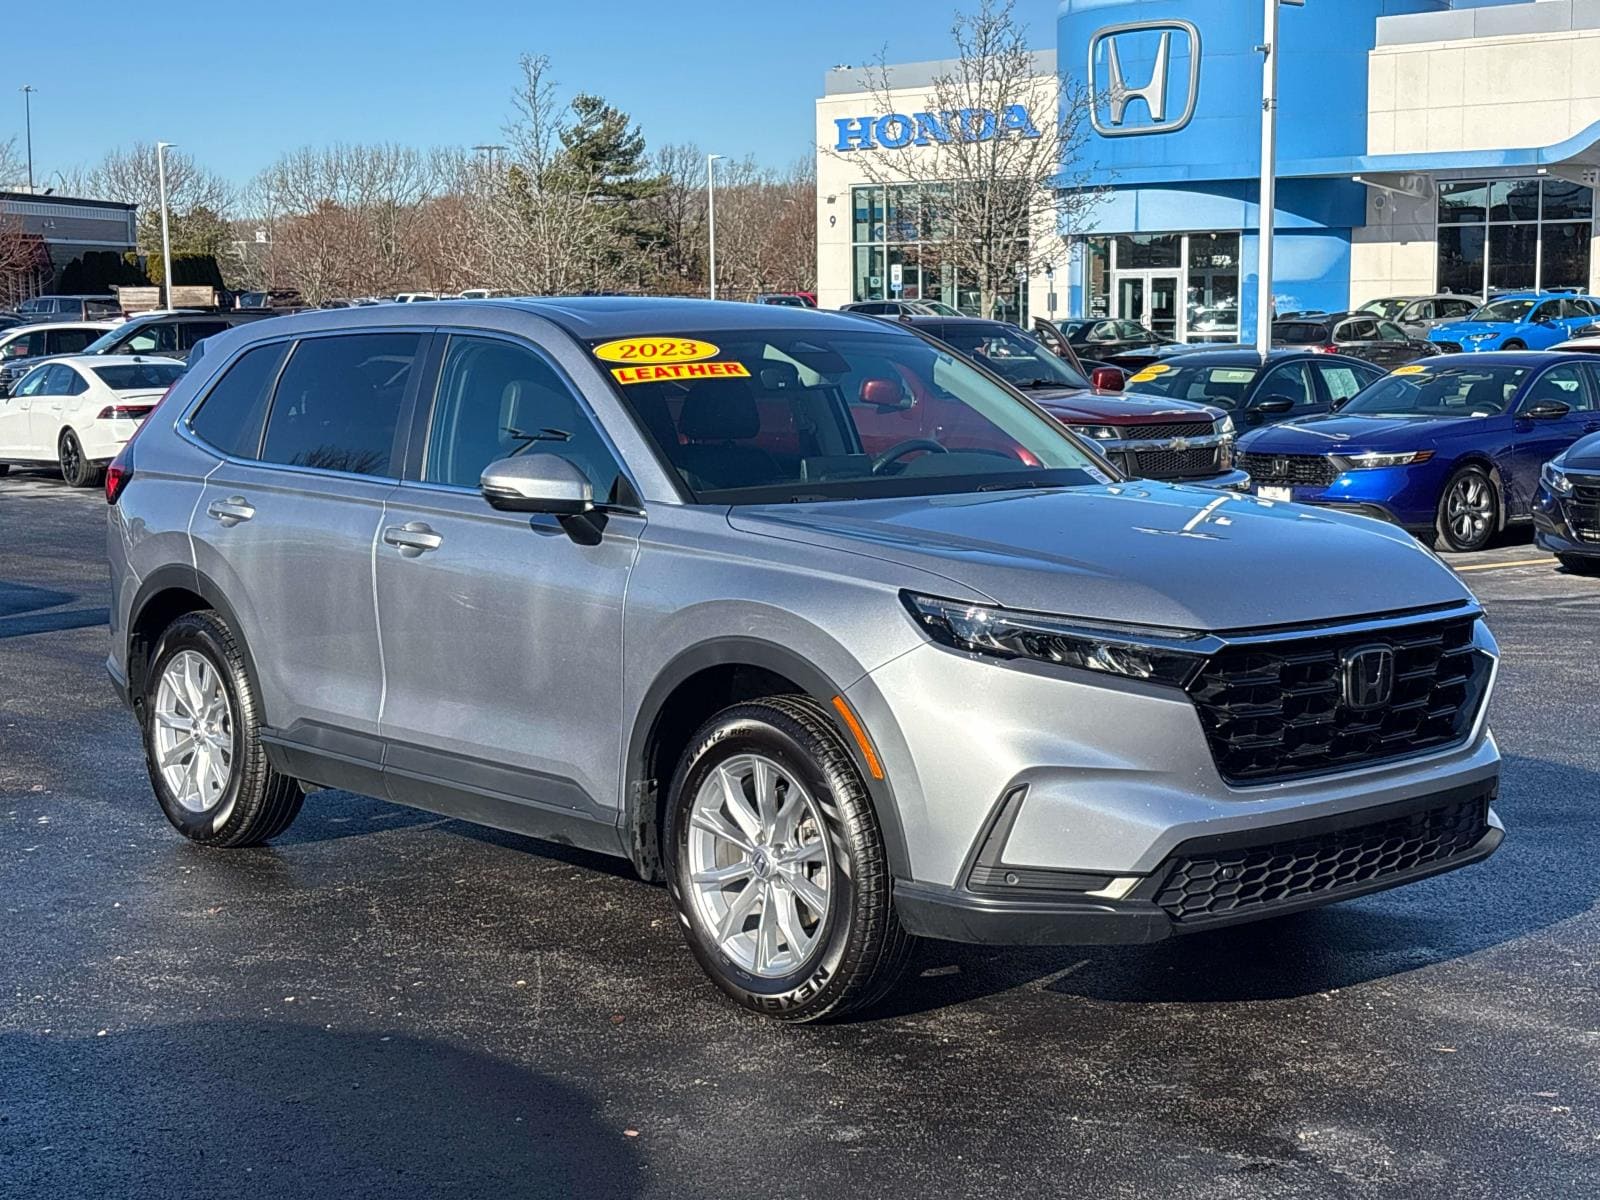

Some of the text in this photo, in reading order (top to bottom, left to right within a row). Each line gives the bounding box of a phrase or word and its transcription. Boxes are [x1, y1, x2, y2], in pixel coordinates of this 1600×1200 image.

[834, 104, 1040, 151] HONDA
[829, 215, 836, 228] 9
[619, 342, 698, 359] 2023
[618, 363, 745, 382] LEATHER
[746, 965, 831, 1011] NEXEN
